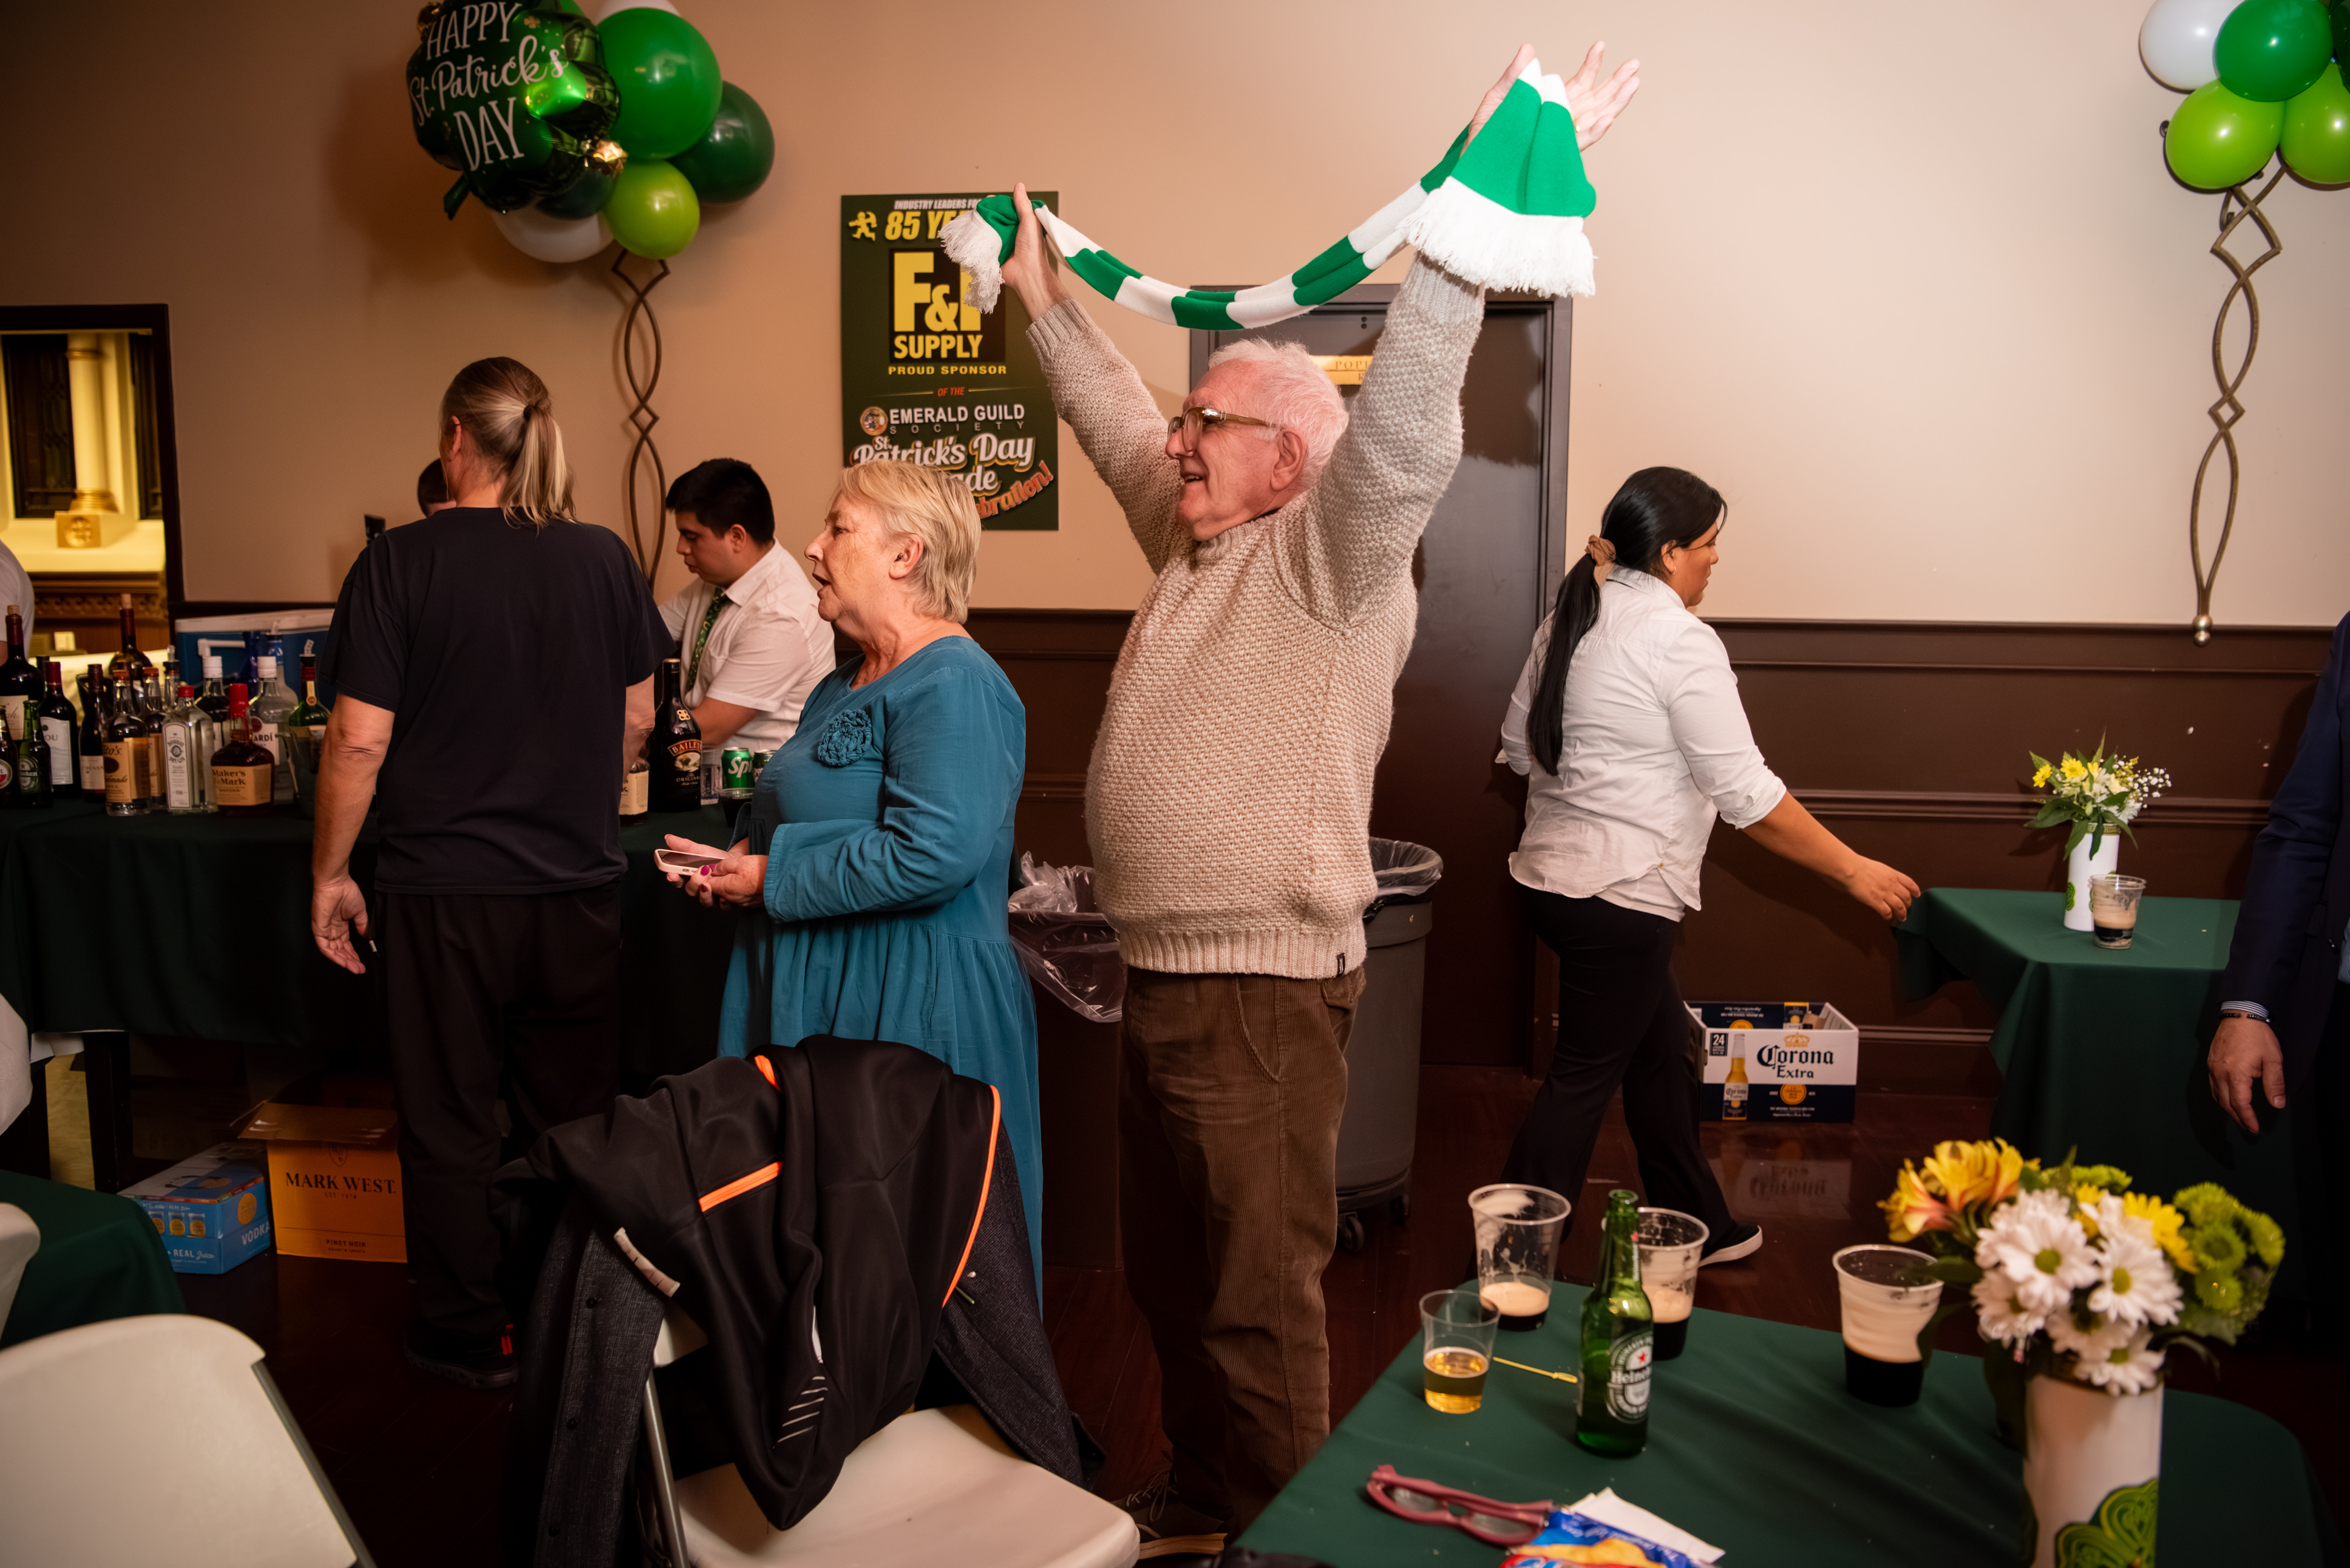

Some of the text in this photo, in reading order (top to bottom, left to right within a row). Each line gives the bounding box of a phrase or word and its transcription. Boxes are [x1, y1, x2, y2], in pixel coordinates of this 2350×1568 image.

[426, 2, 522, 60] HAPPY
[409, 35, 569, 126] St. Patrick's
[453, 97, 525, 171] DAY
[894, 199, 983, 210] INDUSTRY LEADERS FO
[885, 211, 921, 240] 85
[894, 334, 983, 359] SUPPLY
[888, 365, 1007, 375] PROUD SPONSOR
[937, 387, 965, 396] OF THE
[889, 404, 1025, 424] EMERALD GUILD
[889, 421, 1024, 434] SOCIETY
[874, 435, 892, 450] St.
[973, 433, 1034, 467] Day
[977, 460, 1054, 520] ebration!
[254, 732, 274, 742] ARDÍ
[1713, 1033, 1725, 1046] 24
[1757, 1044, 1835, 1070] Corona
[1776, 1065, 1815, 1079] Extra
[285, 1172, 396, 1194] MARK WEST
[174, 1249, 195, 1258] REAL
